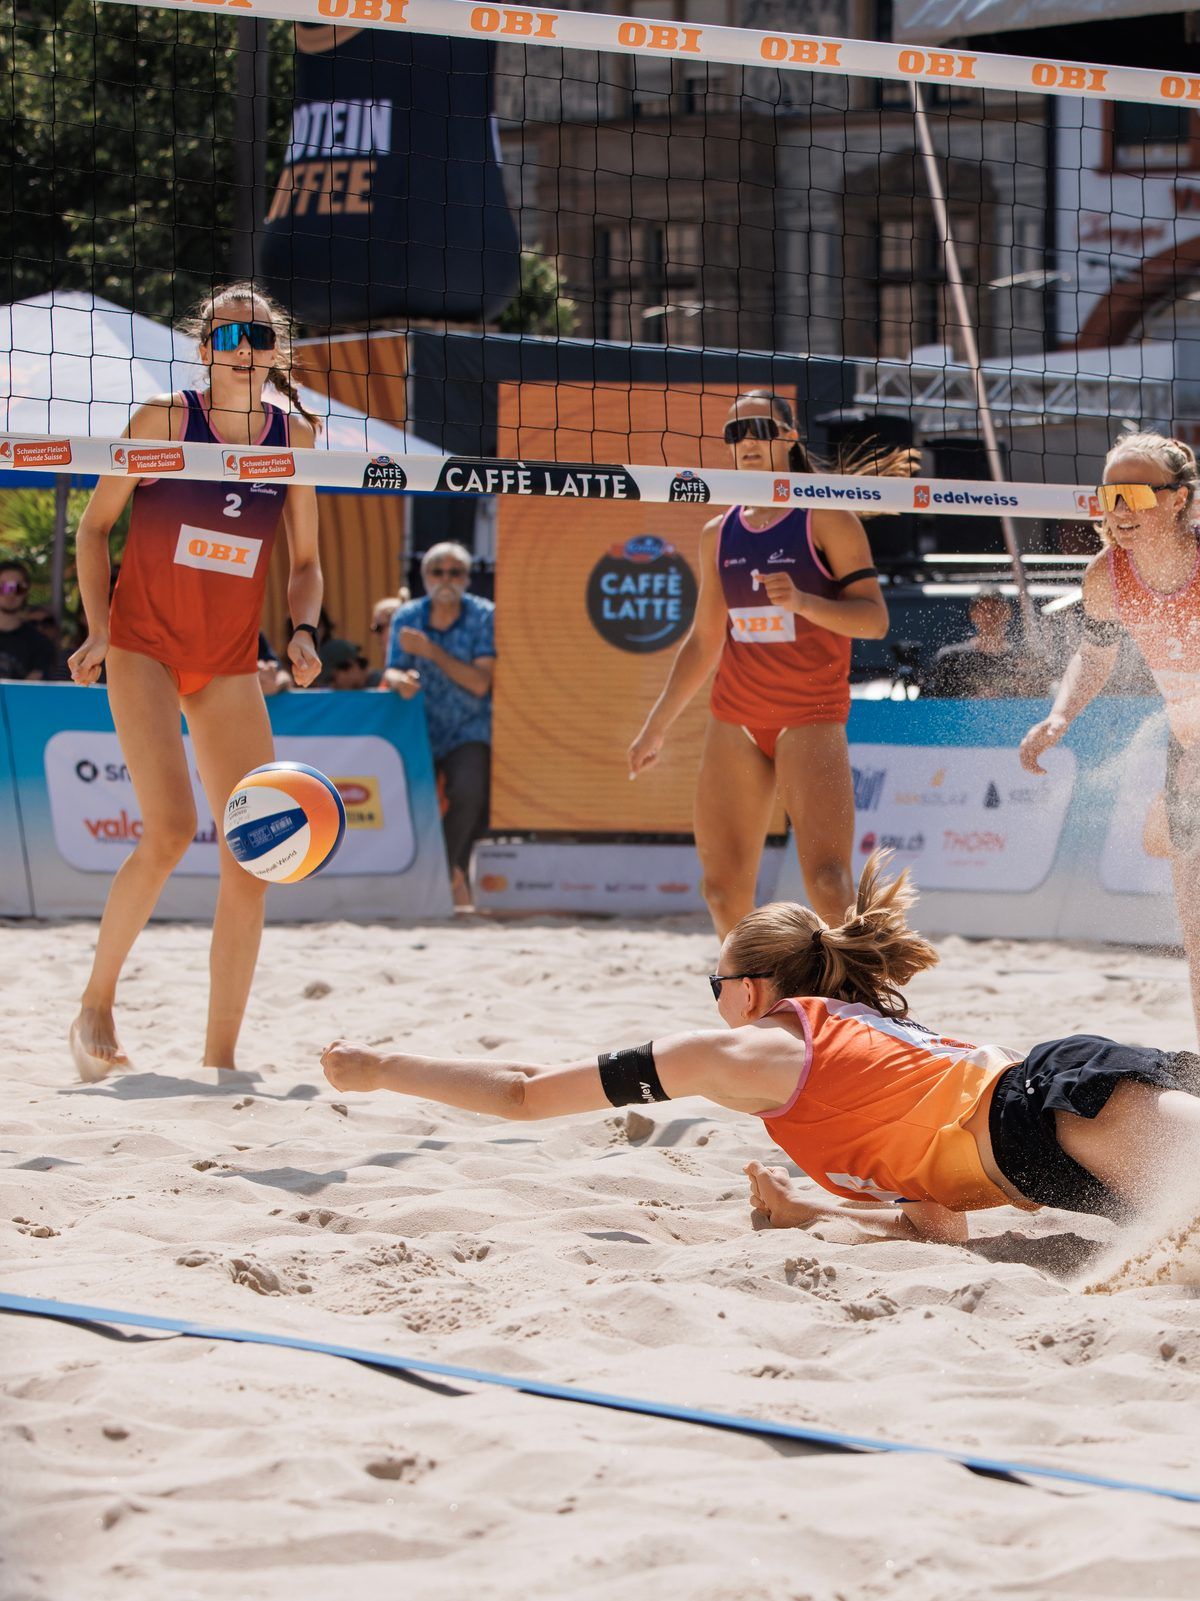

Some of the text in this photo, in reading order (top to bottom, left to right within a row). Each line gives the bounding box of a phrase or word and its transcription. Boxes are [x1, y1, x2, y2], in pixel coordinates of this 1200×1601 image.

[318, 0, 408, 23] OBI
[470, 7, 557, 38] OBI
[617, 22, 702, 52] OBI
[760, 37, 841, 66] OBI
[898, 50, 976, 79] OBI
[1031, 64, 1108, 91] OBI
[284, 99, 391, 163] OTEIN
[266, 160, 377, 220] FFEE
[16, 447, 46, 455] Schweizer
[130, 452, 181, 462] Schweizer Fleisch
[136, 461, 157, 469] Viande
[242, 460, 271, 468] Schweizer
[367, 465, 402, 478] CAFFÈ
[367, 478, 402, 489] LATTE
[445, 462, 627, 499] CAFFÈ LATTE
[673, 480, 706, 492] CAFFÈ
[673, 492, 706, 502] LATTE
[793, 485, 882, 501] edelweiss
[932, 491, 1019, 506] edelweiss
[222, 493, 242, 518] 2
[188, 539, 250, 565] OBI
[600, 566, 682, 595] CAFFÈ
[750, 569, 760, 592] 1
[602, 598, 682, 620] LATTE
